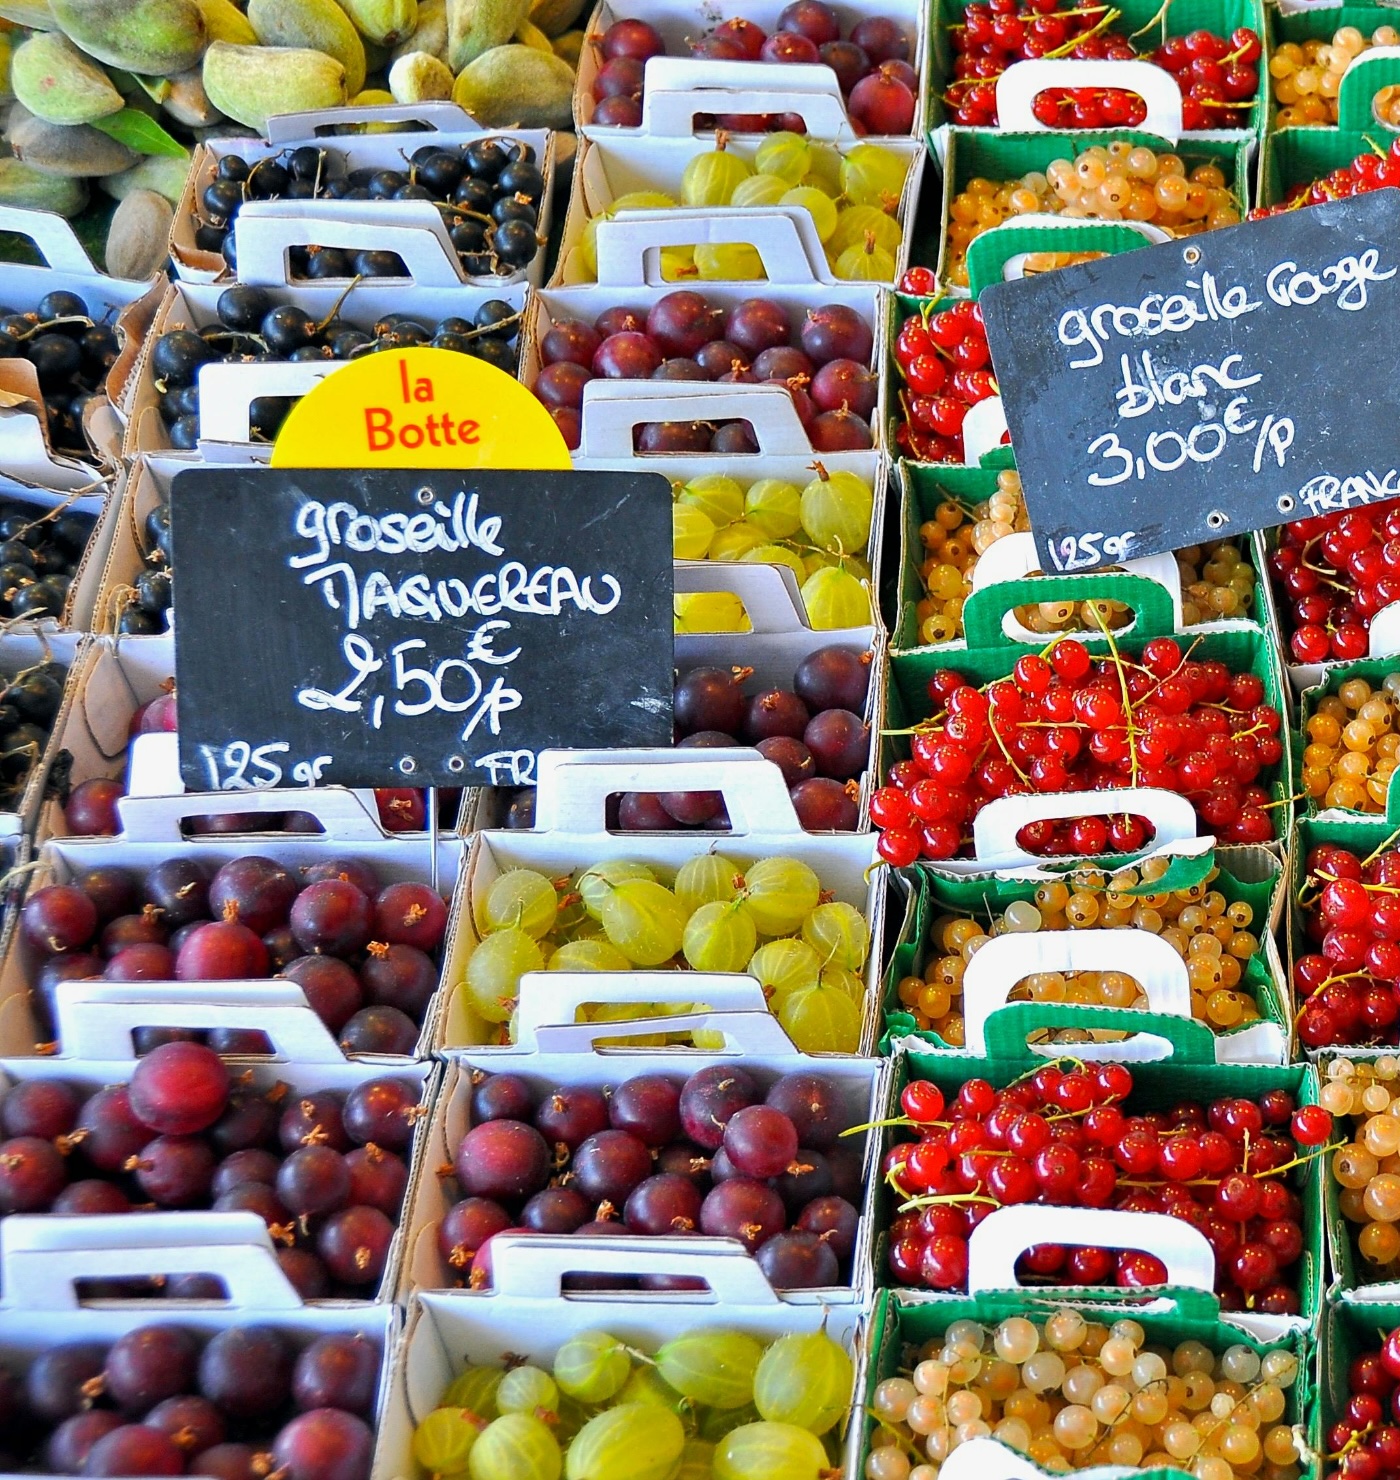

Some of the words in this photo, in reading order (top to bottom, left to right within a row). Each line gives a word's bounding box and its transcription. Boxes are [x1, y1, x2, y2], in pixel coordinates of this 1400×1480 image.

[1057, 271, 1263, 369] groseille
[400, 359, 435, 403] la
[1115, 351, 1263, 419] blanc
[364, 407, 481, 452] Botte
[289, 492, 505, 569] groseille
[304, 561, 622, 629] MAQUEREAU
